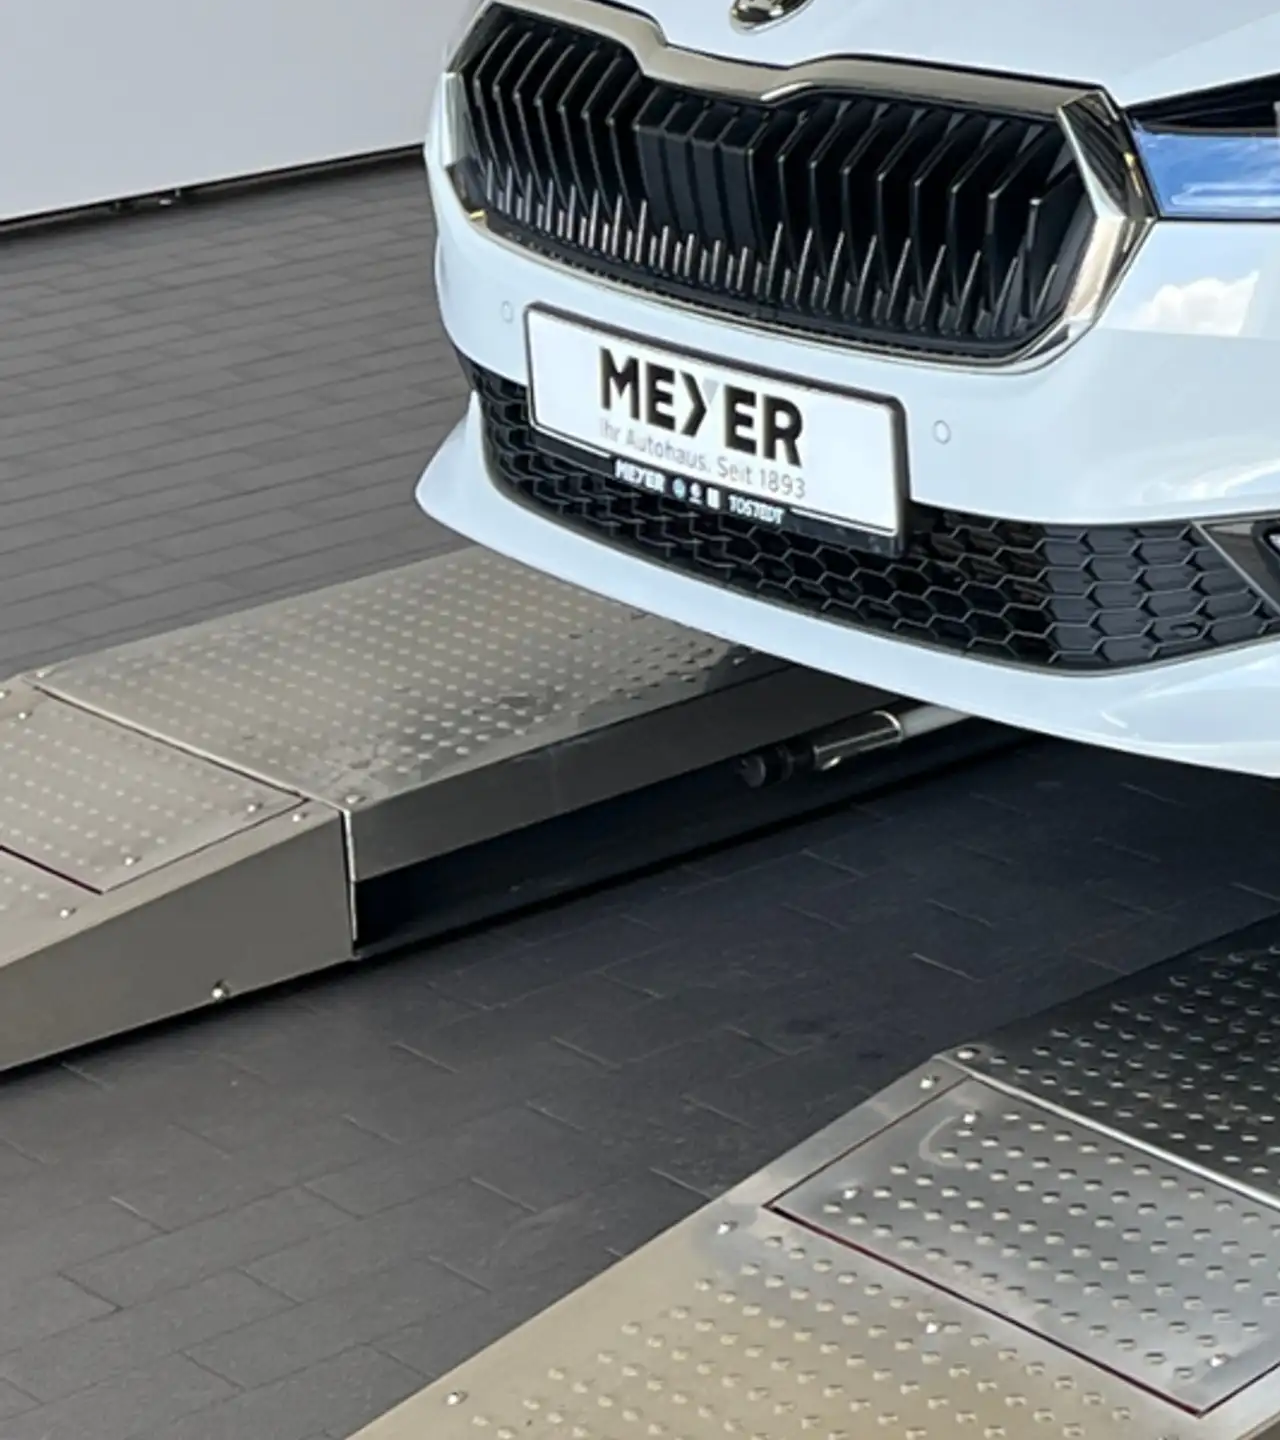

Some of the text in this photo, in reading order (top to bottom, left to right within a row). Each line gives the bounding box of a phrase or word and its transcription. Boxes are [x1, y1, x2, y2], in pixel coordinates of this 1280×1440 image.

[599, 346, 804, 468] MEYER
[600, 418, 806, 499] Ihr Autohaus. Seit 1893
